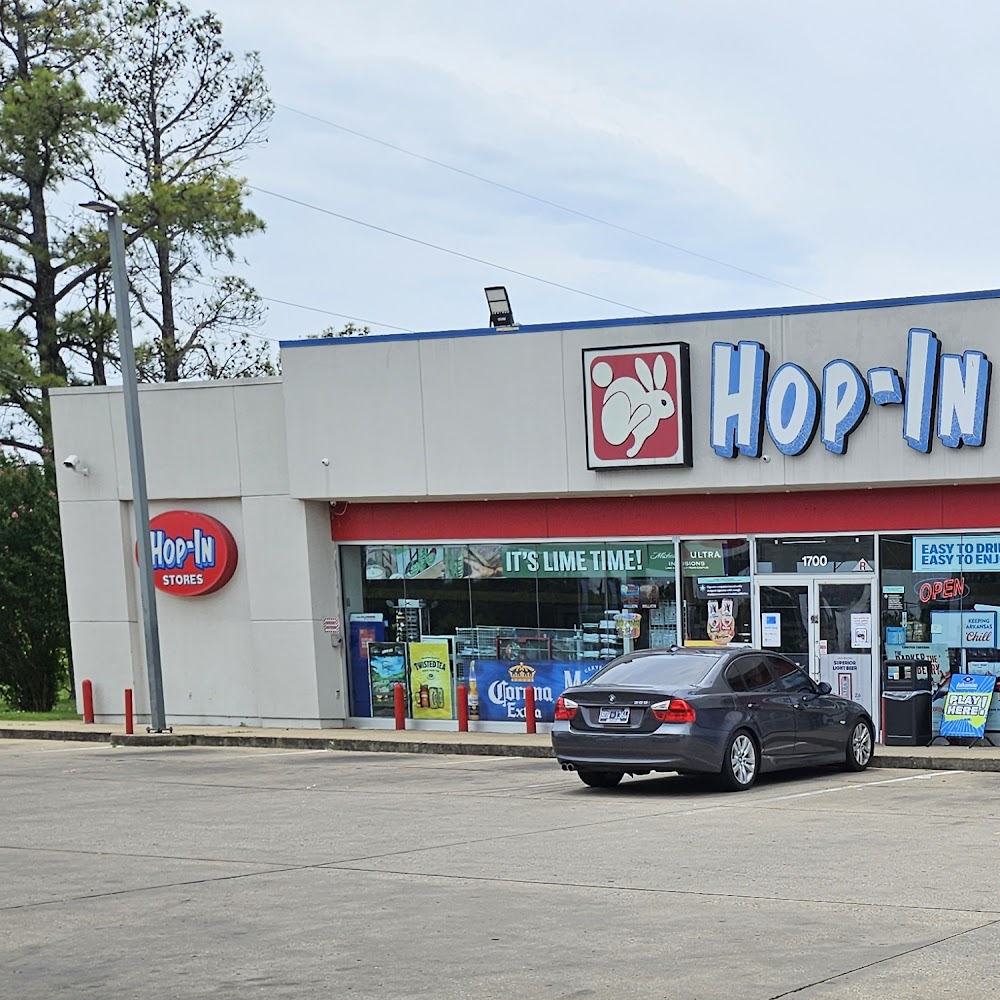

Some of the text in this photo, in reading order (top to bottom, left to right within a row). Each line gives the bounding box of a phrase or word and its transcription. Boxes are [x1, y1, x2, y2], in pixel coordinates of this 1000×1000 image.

[710, 328, 992, 459] HOP-IN
[149, 528, 216, 570] HOP-IN
[921, 543, 955, 554] EASY
[958, 543, 974, 553] TO
[505, 549, 644, 572] IT'S LIME TIME!
[690, 551, 722, 559] ULTRA
[921, 554, 955, 565] EASY
[958, 554, 974, 564] TO
[801, 555, 828, 567] 1700
[162, 574, 204, 585] STORES
[919, 577, 965, 603] OPEN
[965, 631, 992, 642] Chill
[413, 660, 446, 671] TWISTED TEA
[584, 665, 602, 673] CERVE
[487, 680, 554, 707] Corna
[949, 695, 981, 705] PLAY
[507, 702, 542, 718] Exta
